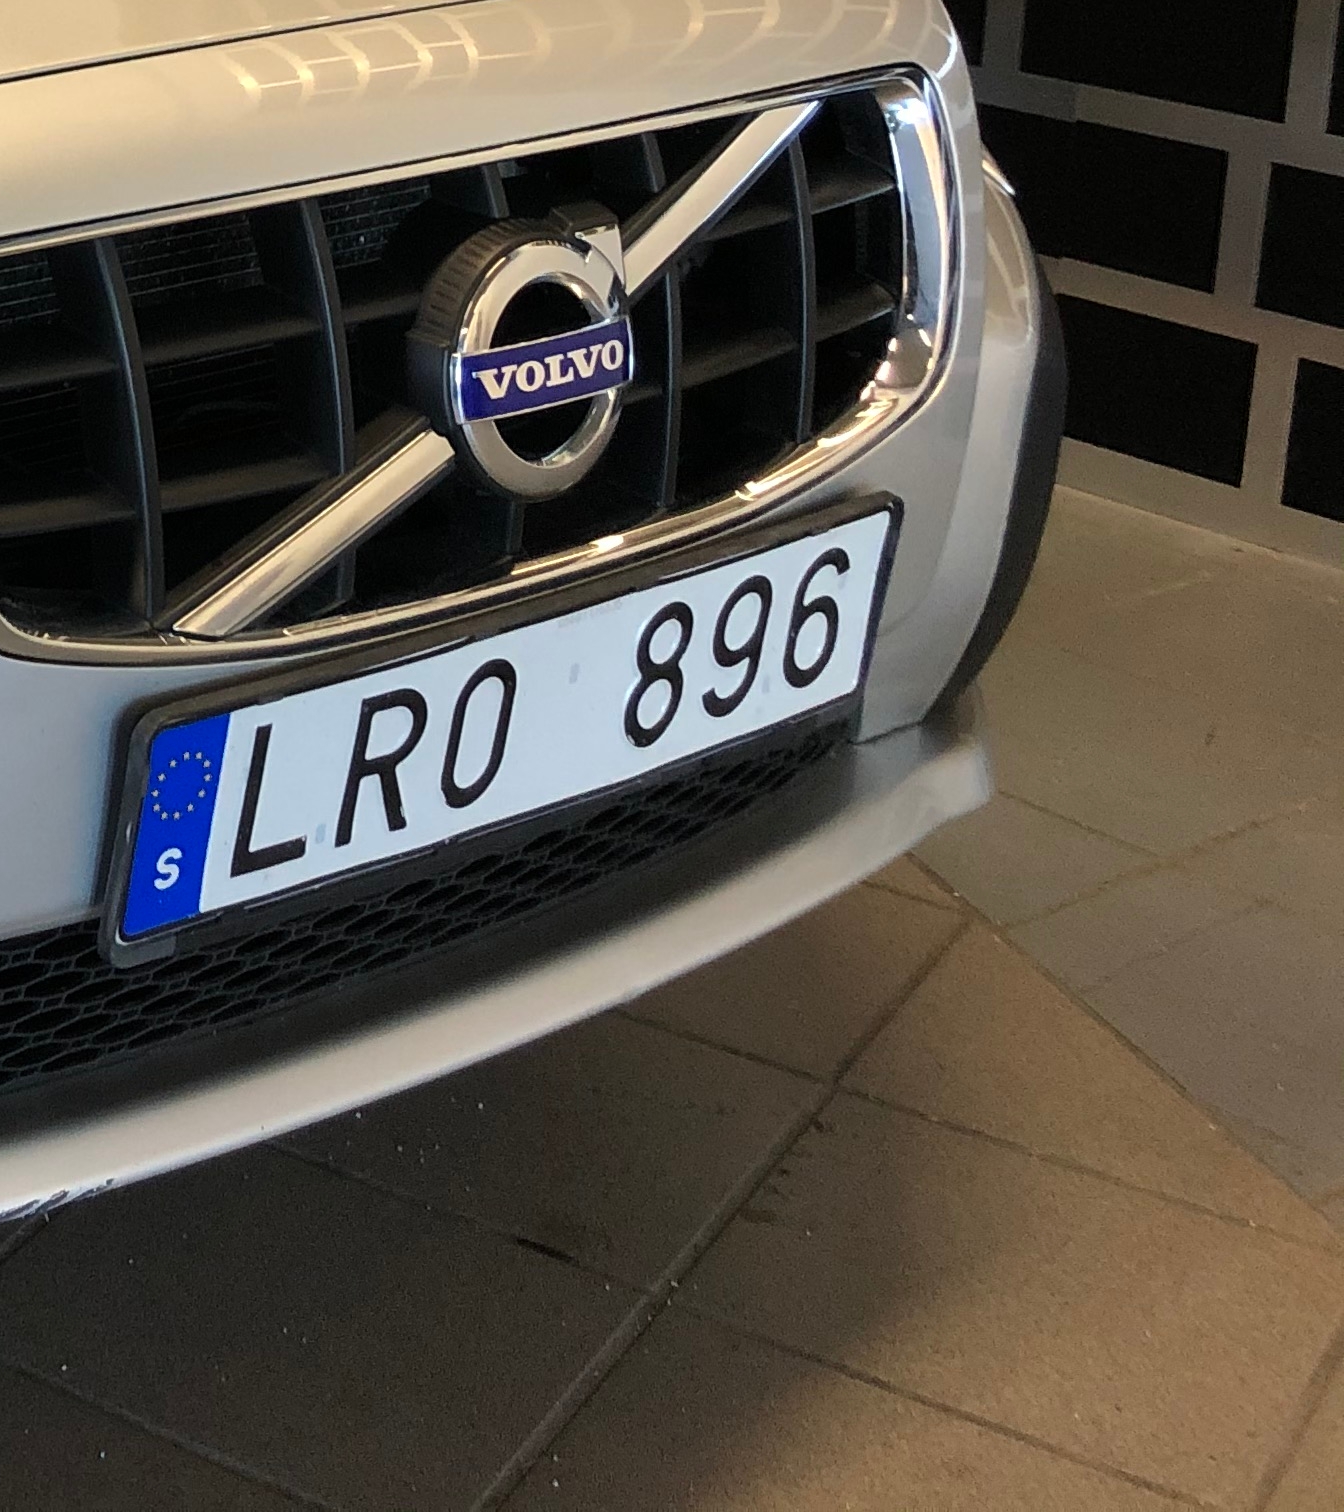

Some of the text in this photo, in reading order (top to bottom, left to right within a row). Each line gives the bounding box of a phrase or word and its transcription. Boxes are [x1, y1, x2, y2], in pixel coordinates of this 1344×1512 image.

[472, 339, 625, 400] VOLVO
[229, 547, 851, 878] LRO 896
[153, 847, 184, 891] S
